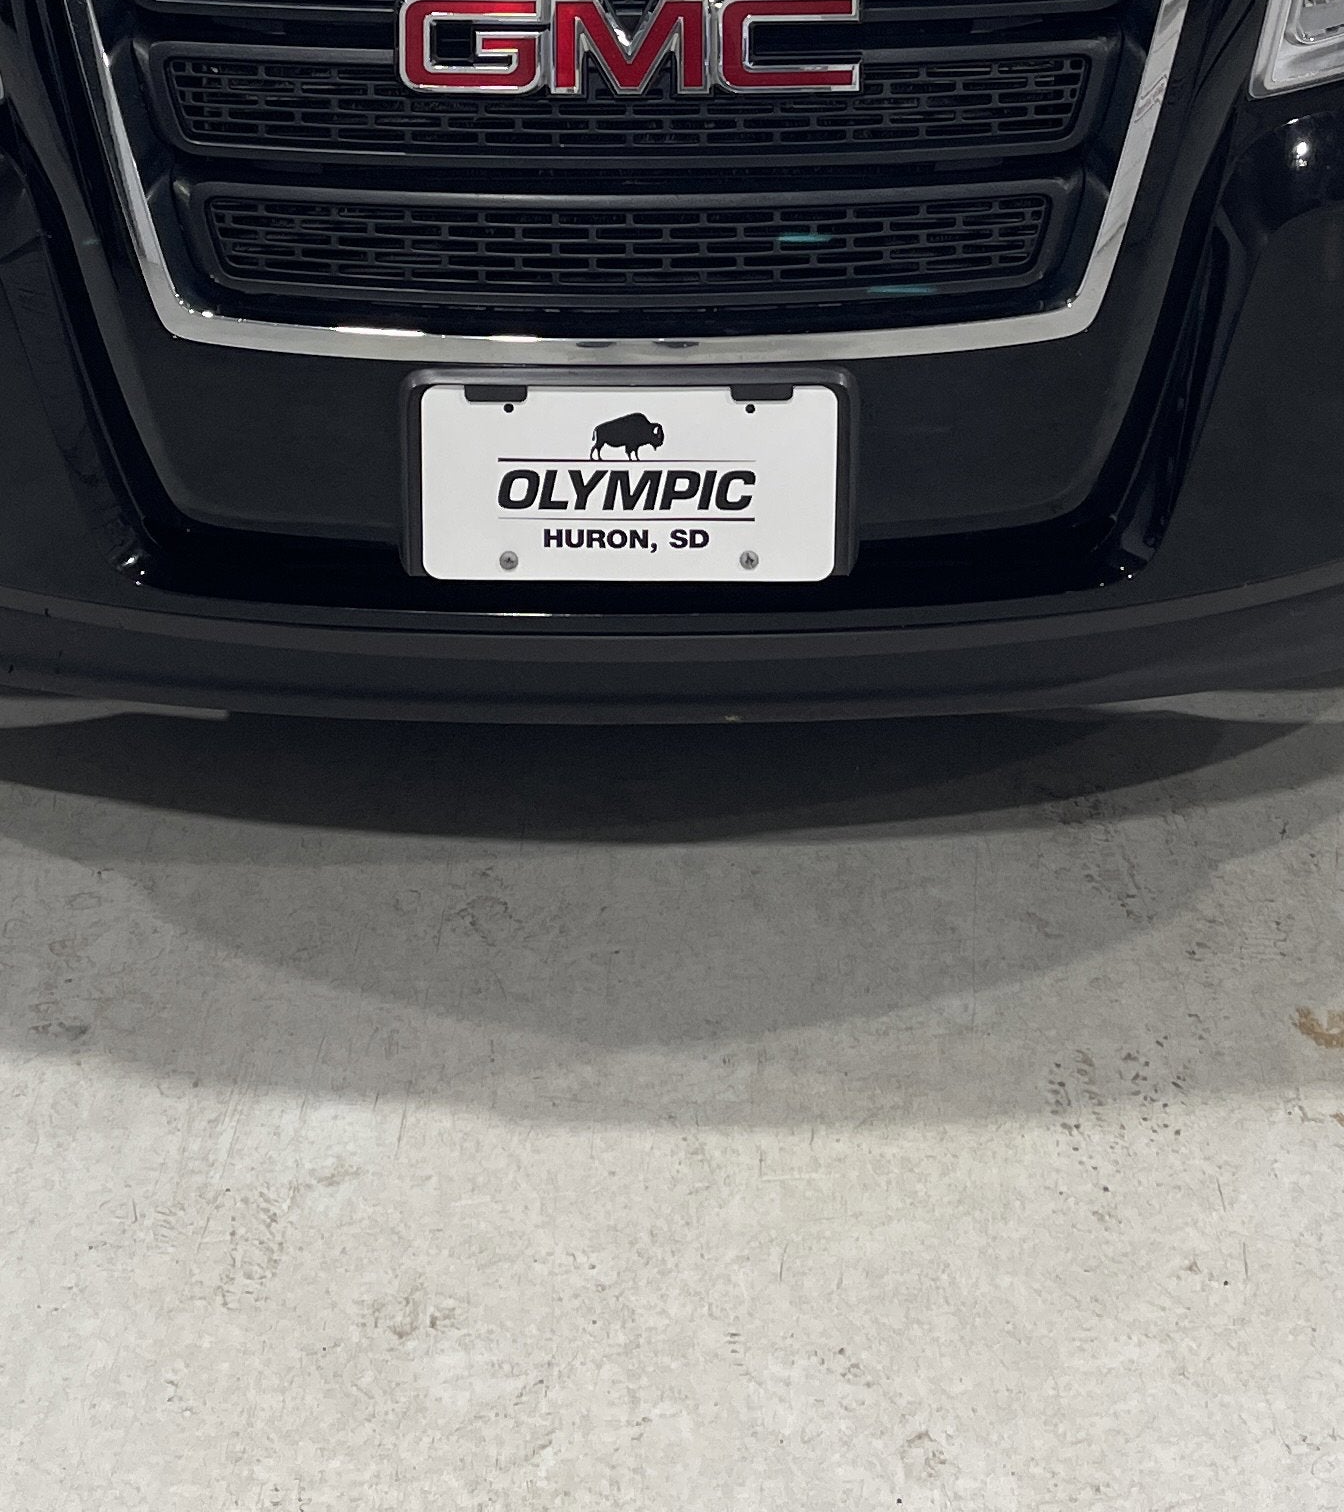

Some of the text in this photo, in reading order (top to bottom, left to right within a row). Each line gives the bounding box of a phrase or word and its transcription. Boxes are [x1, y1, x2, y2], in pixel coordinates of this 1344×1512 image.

[497, 469, 757, 511] OLYMPIC
[542, 529, 710, 553] HURON, SD
